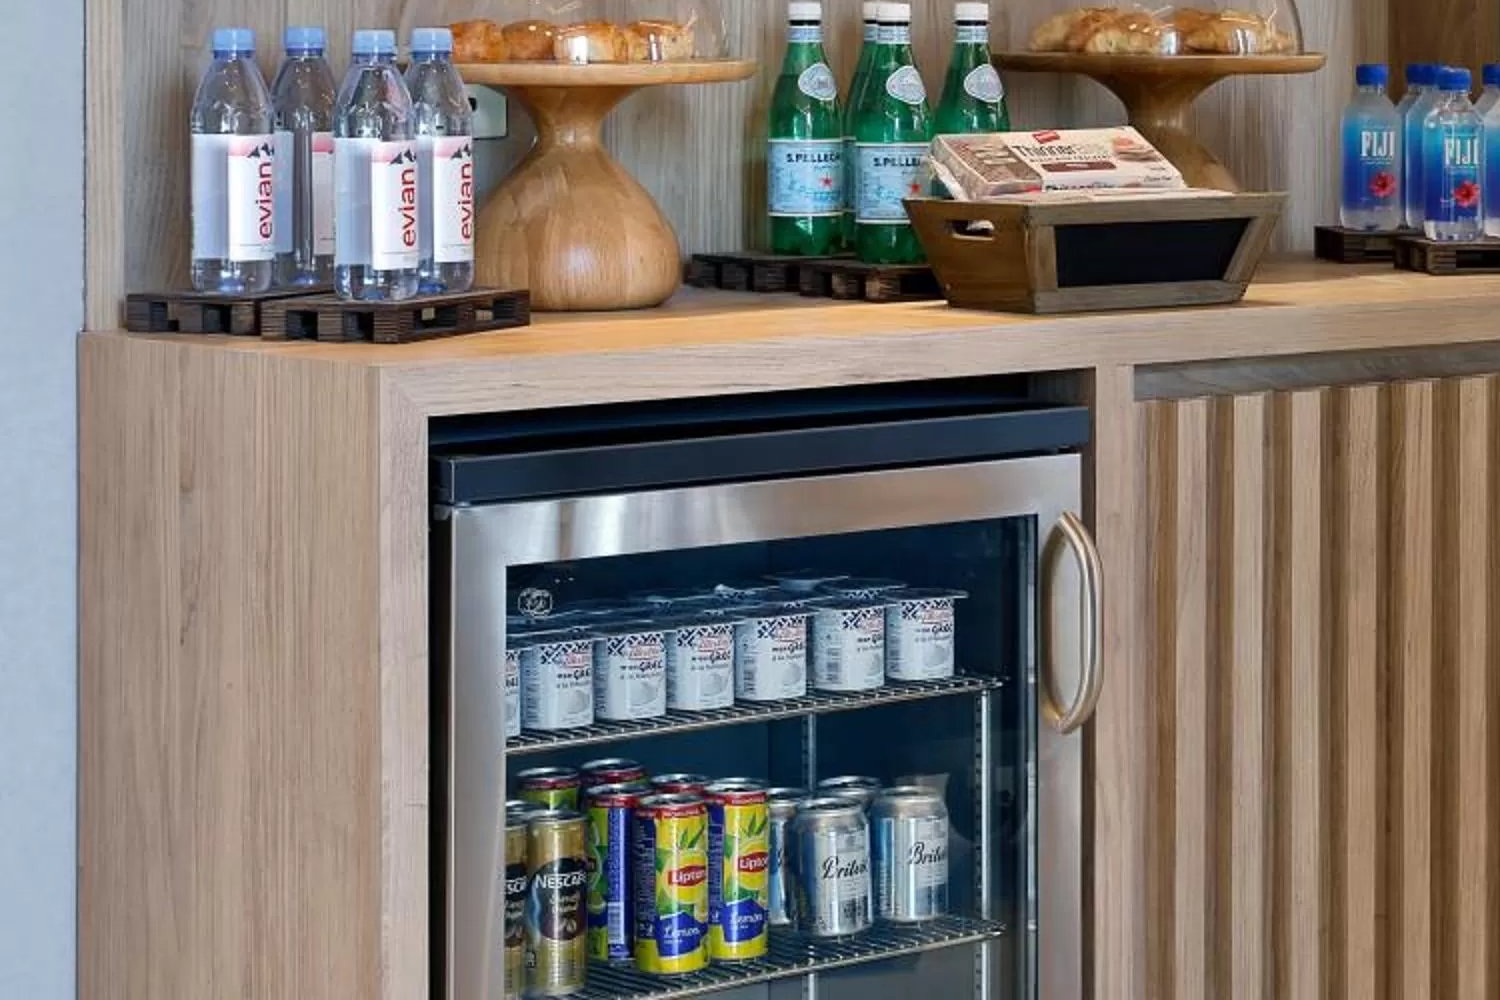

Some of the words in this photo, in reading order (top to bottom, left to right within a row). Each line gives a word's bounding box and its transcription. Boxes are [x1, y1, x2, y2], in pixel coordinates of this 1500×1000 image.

[1360, 130, 1396, 158] FIJI
[1444, 136, 1480, 165] FIJI
[255, 161, 273, 240] evian
[397, 167, 417, 248] evian
[457, 162, 473, 240] evian
